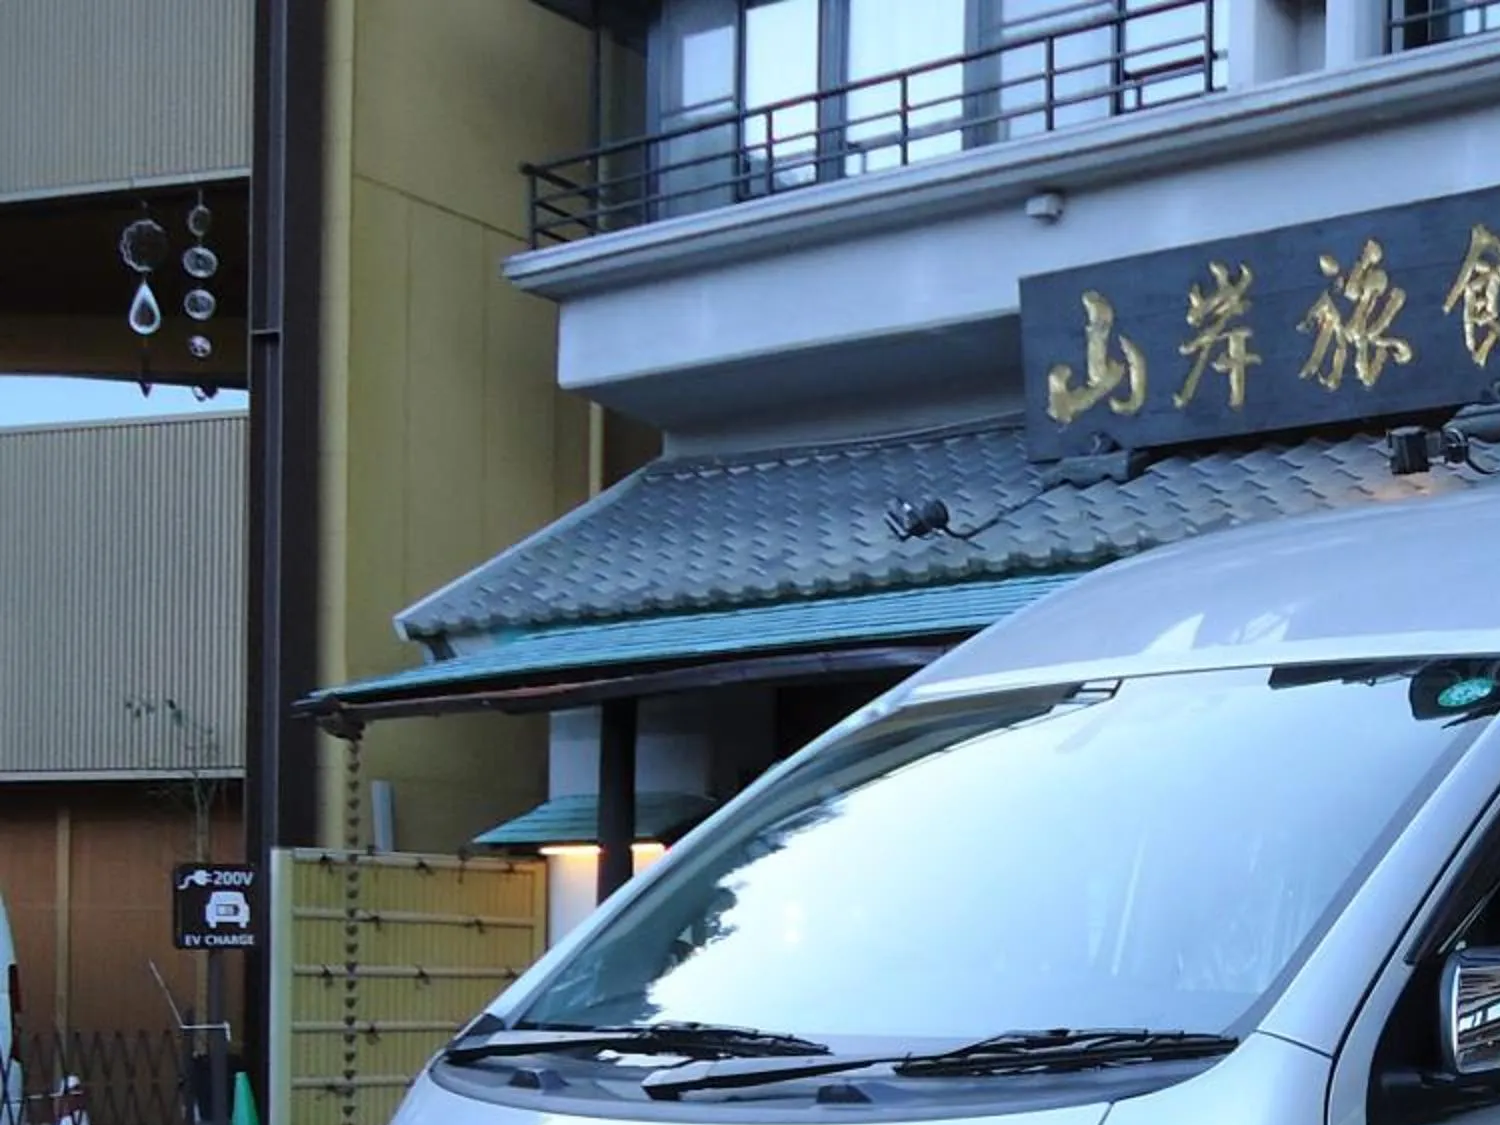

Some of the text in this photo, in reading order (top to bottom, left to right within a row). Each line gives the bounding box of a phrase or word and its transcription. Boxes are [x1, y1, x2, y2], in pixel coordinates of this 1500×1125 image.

[213, 871, 254, 886] 200V
[185, 934, 254, 946] EV CHARGE
